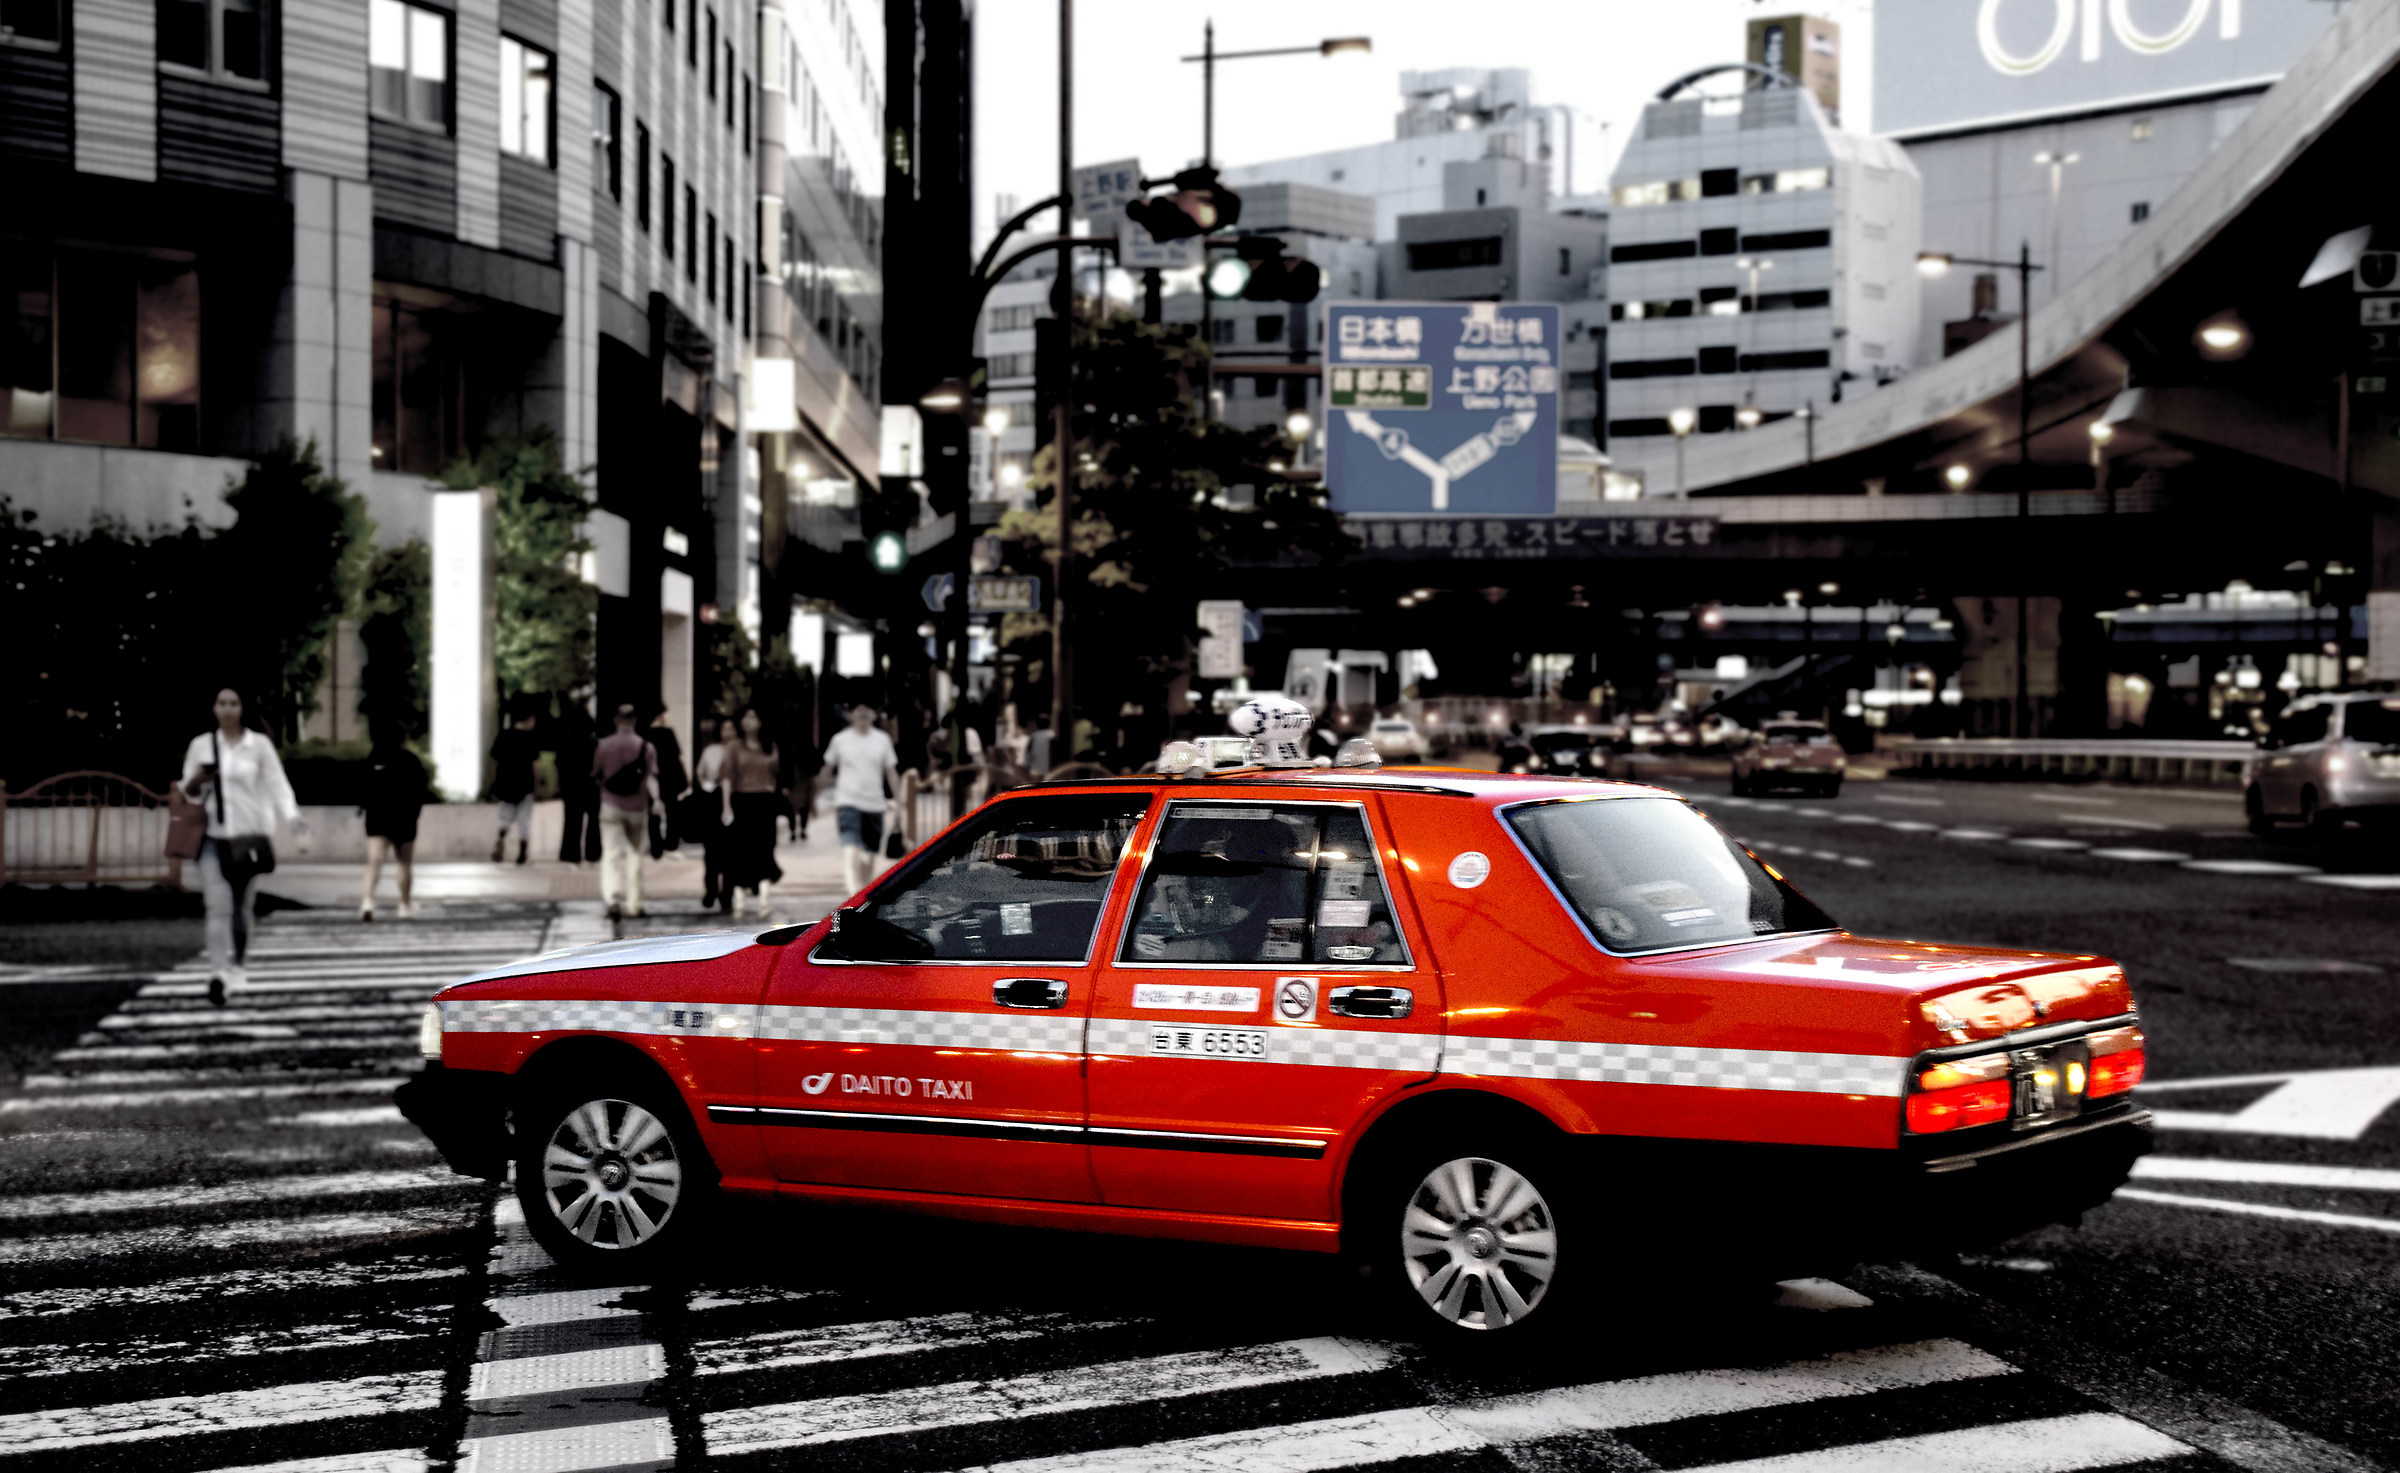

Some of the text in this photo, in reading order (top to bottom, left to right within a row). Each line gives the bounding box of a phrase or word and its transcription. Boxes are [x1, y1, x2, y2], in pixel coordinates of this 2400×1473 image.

[1338, 315, 1423, 345] 日本橋
[1202, 1032, 1266, 1055] 6553
[841, 1073, 973, 1101] DAITO TAXI
